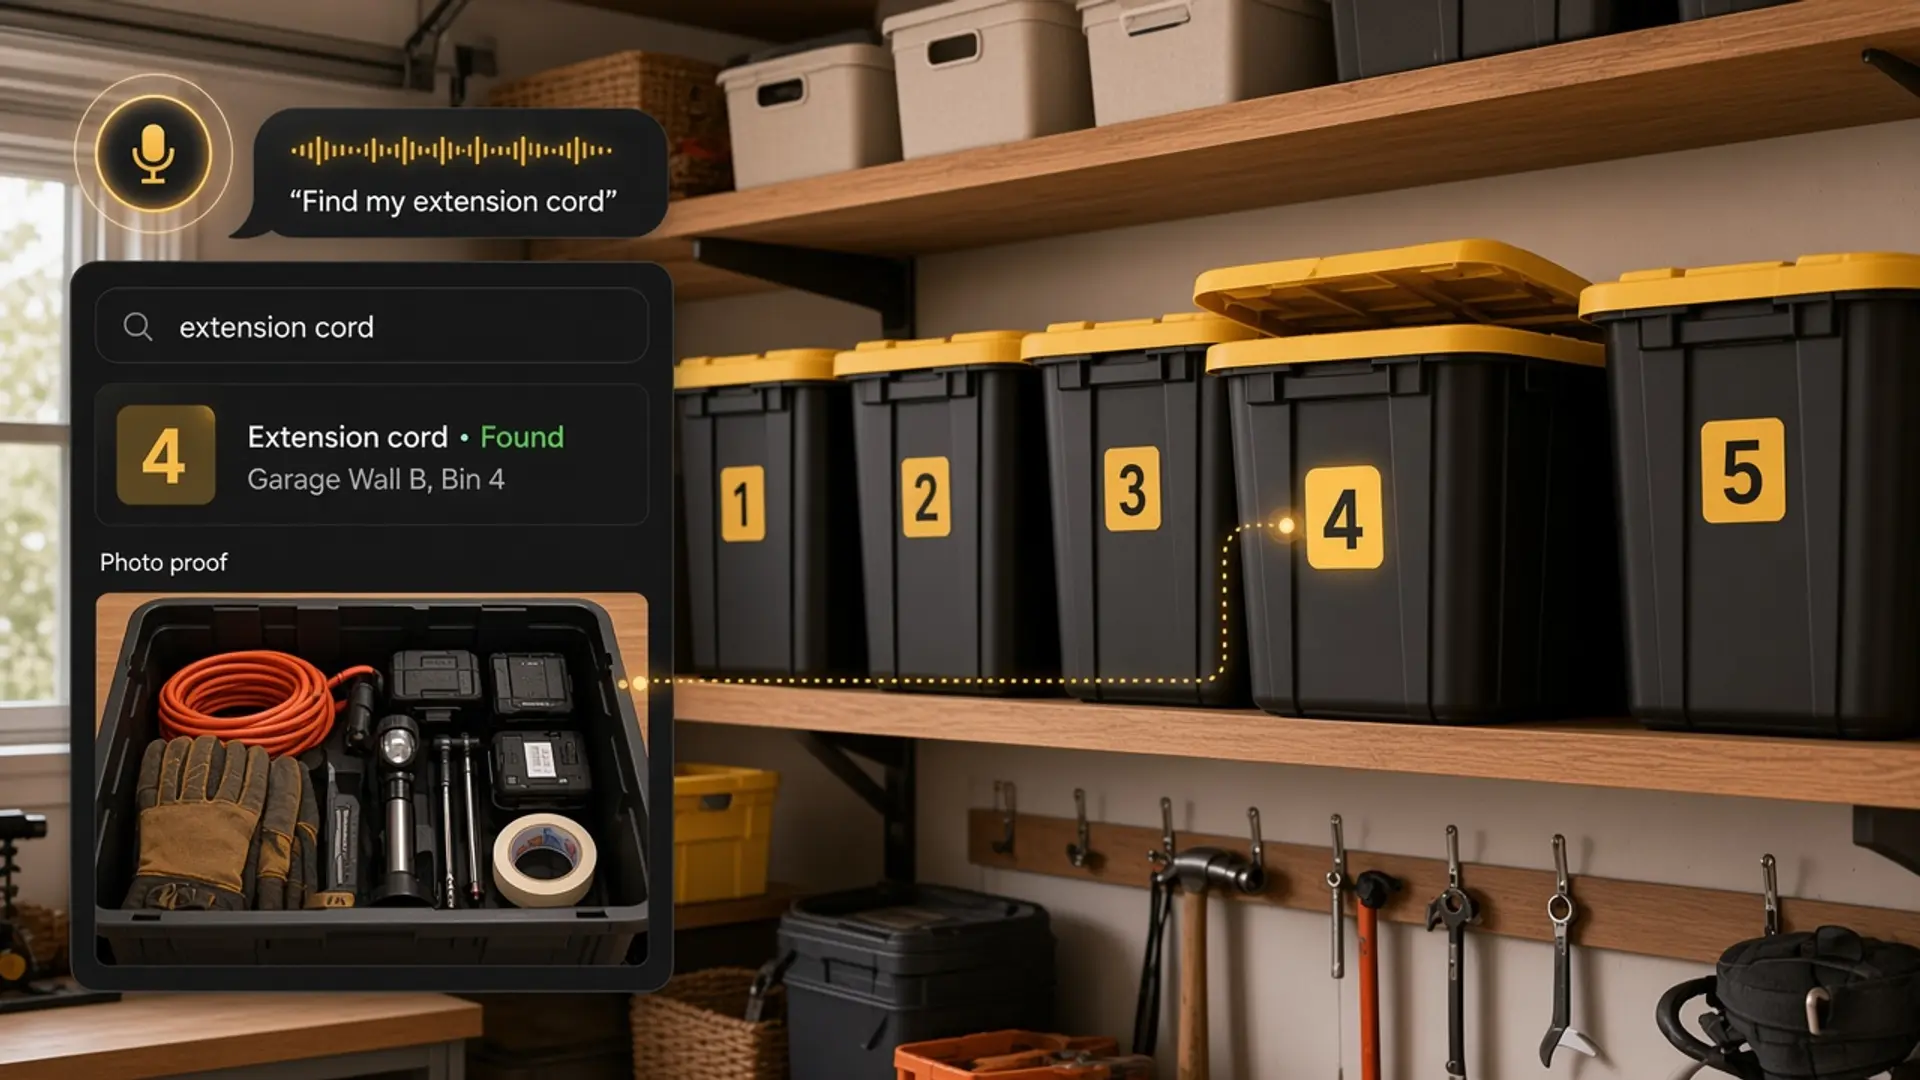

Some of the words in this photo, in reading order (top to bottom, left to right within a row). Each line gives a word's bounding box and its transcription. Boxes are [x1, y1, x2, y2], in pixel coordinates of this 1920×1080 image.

[915, 473, 938, 522] 2
[1119, 463, 1146, 516] 3
[1723, 439, 1763, 505] 5
[733, 482, 748, 527] 1
[1323, 489, 1363, 550] 4
